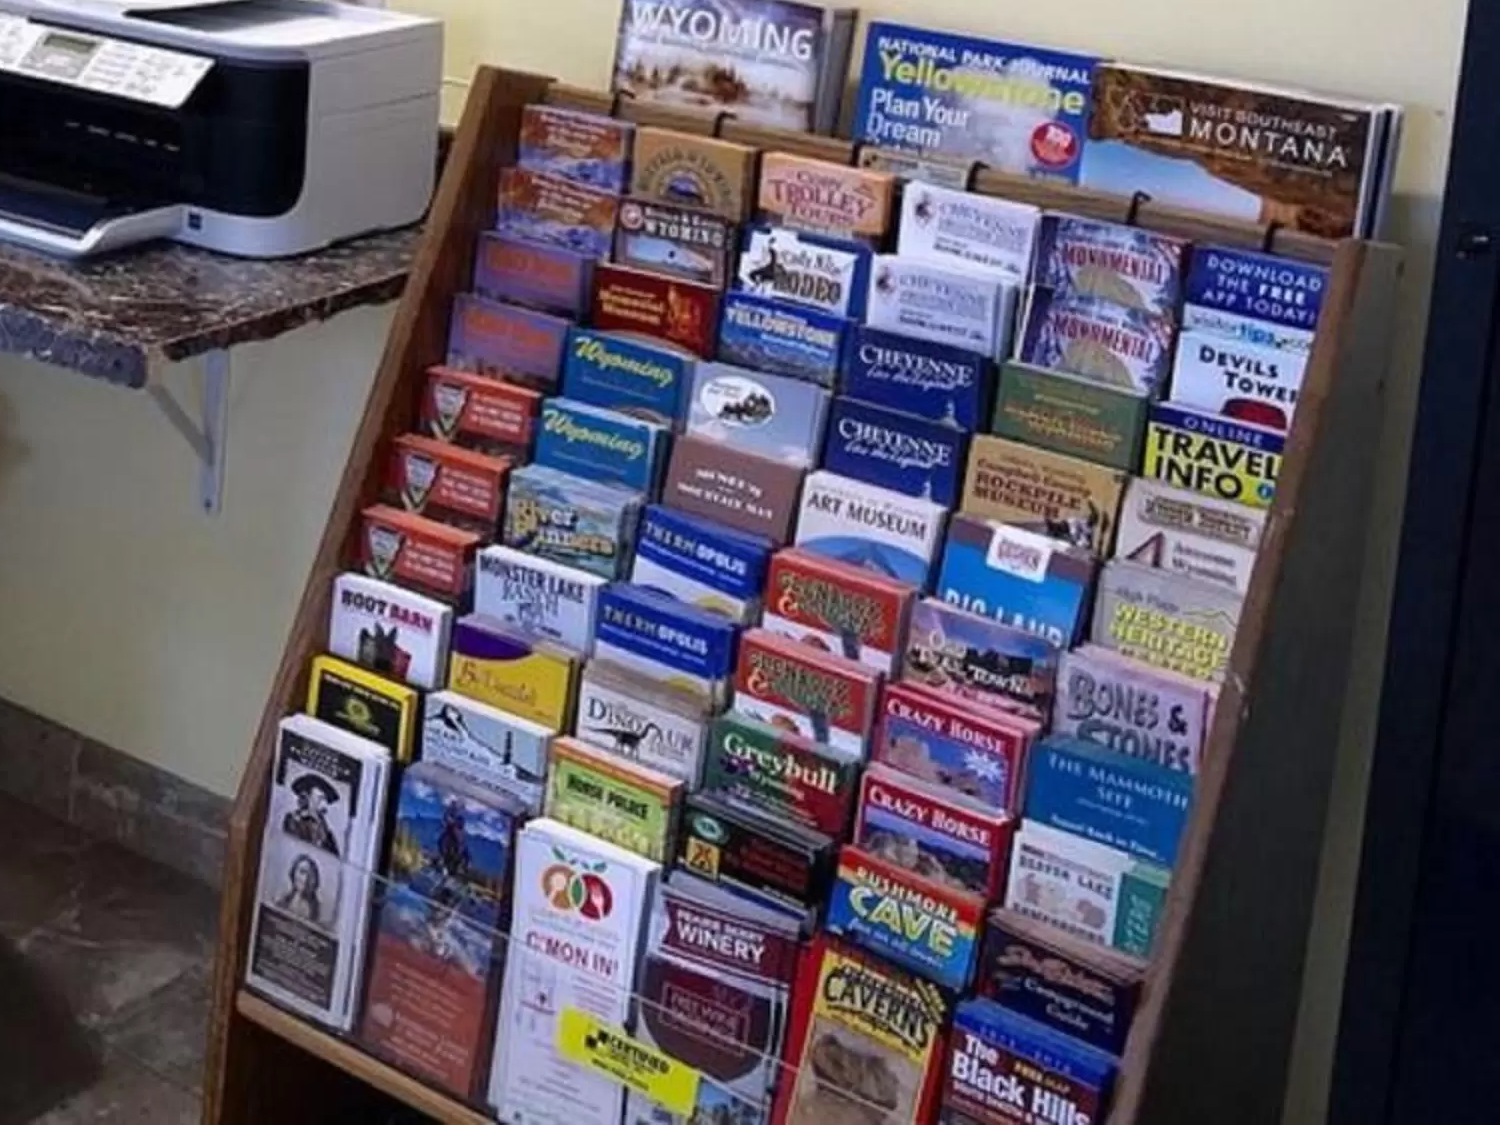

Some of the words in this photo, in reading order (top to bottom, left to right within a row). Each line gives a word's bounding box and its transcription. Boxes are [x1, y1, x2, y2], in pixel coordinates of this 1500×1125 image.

[878, 37, 956, 64] NATIONAL
[961, 50, 1007, 70] PARK
[1007, 58, 1091, 86] JOURNAL
[879, 49, 1086, 116] Yellowstone
[866, 111, 942, 148] Dream
[870, 87, 920, 118] Plan
[923, 95, 969, 127] Your
[1189, 100, 1232, 122] VISIT
[1234, 107, 1338, 140] SOUTHEAST
[1188, 120, 1348, 168] MONTANA
[768, 178, 876, 217] TROLLEY
[645, 220, 724, 248] WYOMING
[1206, 255, 1323, 292] DOWNLOAD
[1216, 274, 1250, 296] THE
[1257, 282, 1307, 305] FREE
[1202, 288, 1238, 310] APP
[725, 307, 837, 350] YELLOWSTONE
[574, 335, 674, 389] Wyoming
[859, 342, 974, 388] CHEYENNE
[1198, 344, 1280, 379] DEVILS
[542, 408, 644, 463] Wyoming
[838, 417, 953, 468] CHEYENNE
[1153, 426, 1279, 481] TRAVEL
[1183, 415, 1264, 448] ONLINE
[975, 473, 1083, 512] ROCKPILE
[1153, 455, 1244, 501] INFO
[807, 492, 843, 519] ART
[846, 501, 928, 543] MUSEUM
[645, 520, 747, 576] THERMOPOLIS
[340, 588, 386, 616] BOOT
[388, 604, 433, 634] BARN
[549, 571, 586, 605] LAKE
[602, 604, 710, 656] THERMOPOLIS
[1115, 600, 1227, 650] WESTERN
[886, 696, 946, 737] CRAZY
[948, 715, 1006, 754] HORSE
[1065, 674, 1161, 732] BONES
[1167, 704, 1190, 737] &
[722, 731, 838, 796] Greybull
[1048, 751, 1084, 779] THE
[1087, 763, 1190, 811] MAMMOTH
[868, 784, 928, 823] CRAZY
[931, 807, 991, 846] HORSE
[1095, 785, 1133, 810] SITE
[855, 864, 960, 925] RUSHMORE
[676, 920, 766, 965] WINERY
[849, 884, 959, 954] CAVE
[823, 967, 936, 1050] CAVERNS
[608, 1033, 672, 1074] CERTIFIED
[964, 1033, 1000, 1066] The
[950, 1046, 1027, 1110] Black
[1030, 1088, 1092, 1125] Hills
